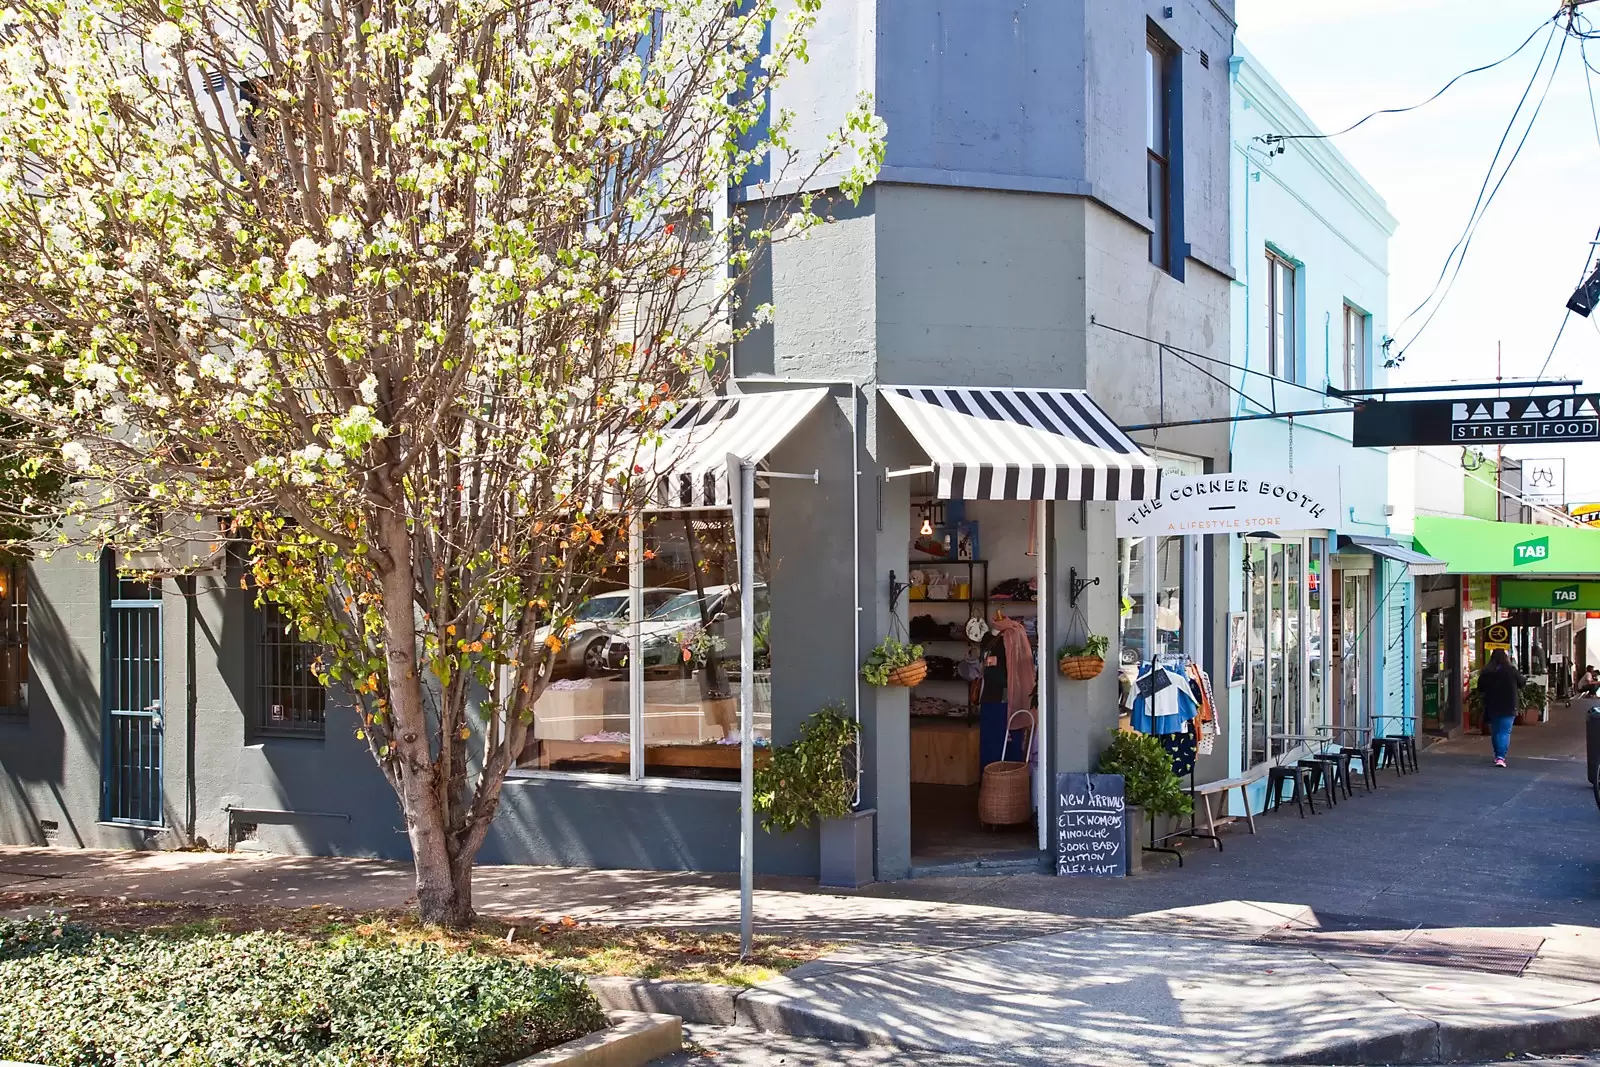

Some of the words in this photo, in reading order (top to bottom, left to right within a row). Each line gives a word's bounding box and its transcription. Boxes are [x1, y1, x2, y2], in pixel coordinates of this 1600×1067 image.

[1452, 401, 1511, 421] BAR
[1520, 398, 1599, 419] ASIA
[1458, 424, 1532, 438] STREET
[1542, 423, 1593, 435] FOOD
[1127, 498, 1163, 525] THE
[1169, 479, 1249, 501] CORNER
[1258, 480, 1327, 519] BOOTH
[1180, 519, 1240, 530] LIFESTYLE
[1245, 517, 1281, 527] STORE
[1516, 545, 1546, 558] TAB
[1554, 590, 1577, 600] TAB
[1058, 814, 1086, 827] ELK
[1059, 842, 1089, 853] SOOKI
[1092, 841, 1120, 856] BABY
[1060, 864, 1086, 875] ALEX
